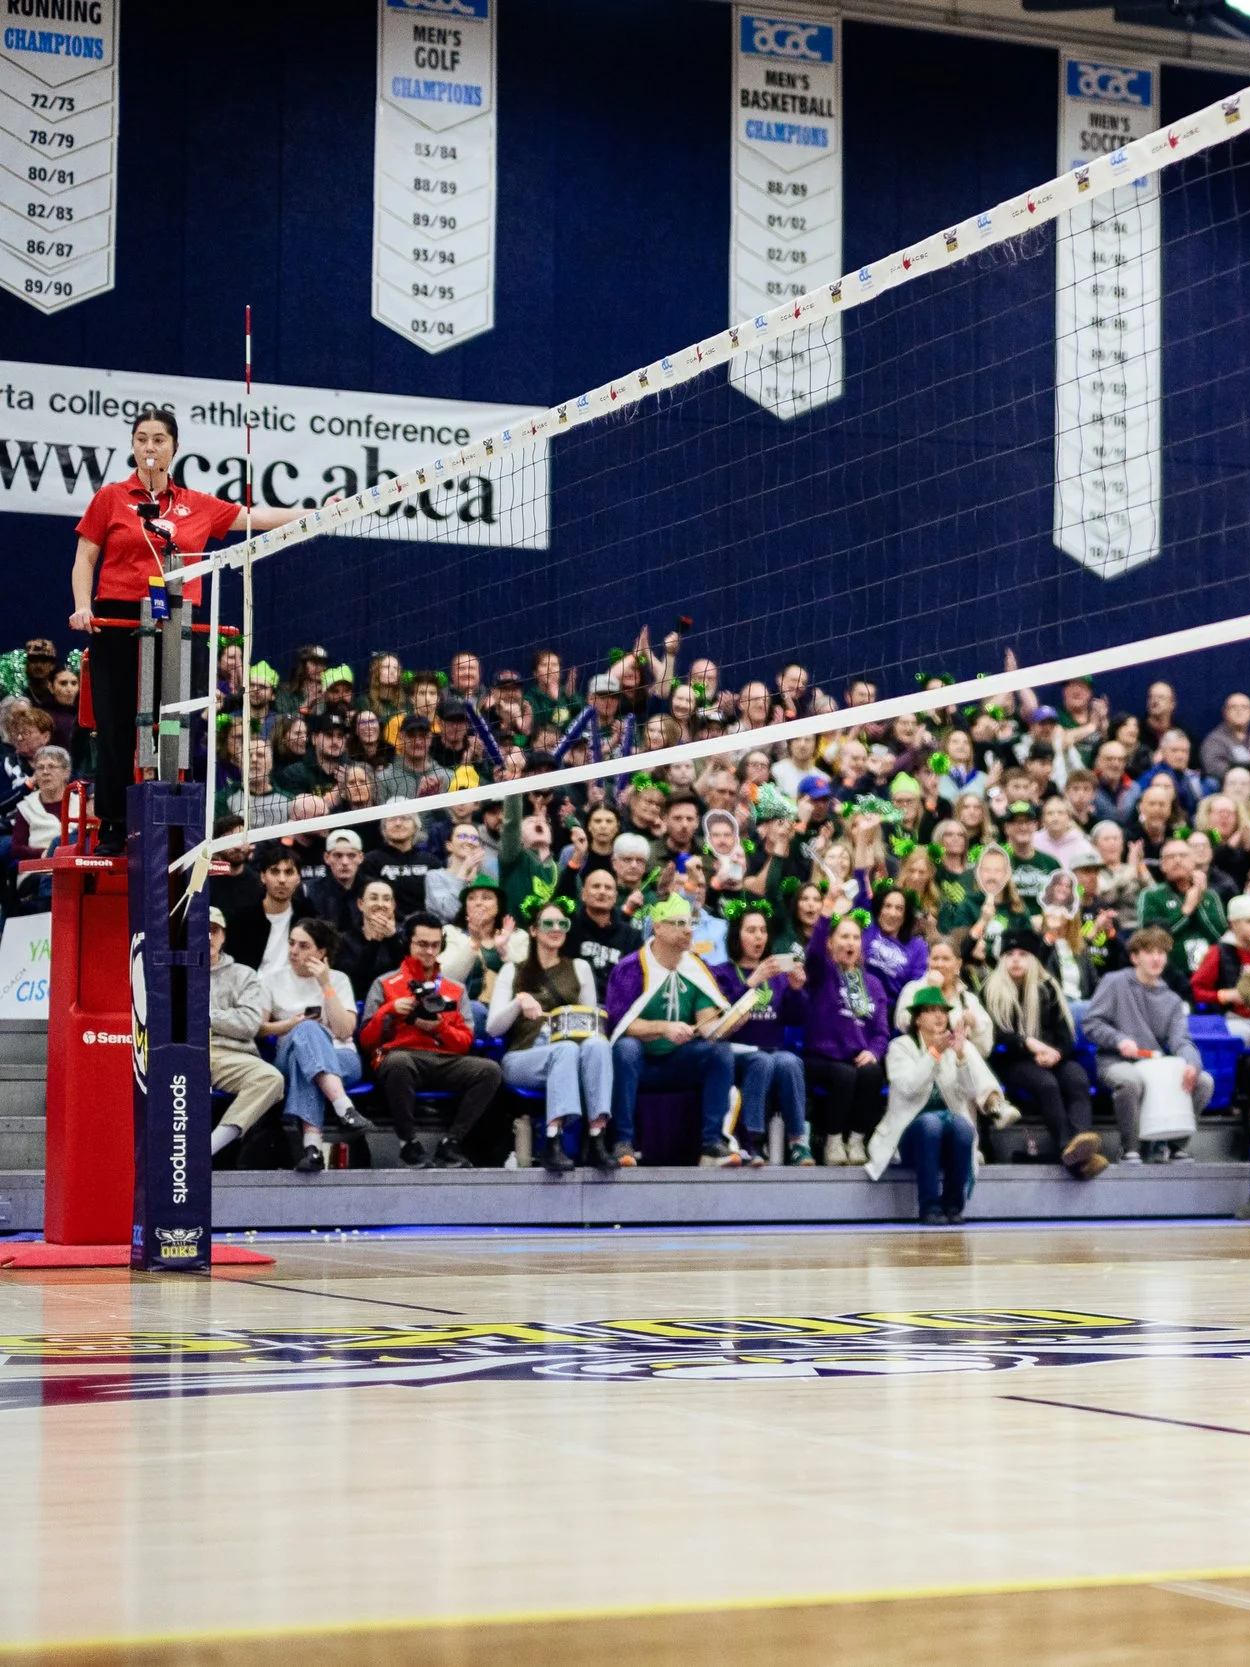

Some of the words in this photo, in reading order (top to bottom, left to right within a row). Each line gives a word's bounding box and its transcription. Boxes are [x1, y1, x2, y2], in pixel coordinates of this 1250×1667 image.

[7, 0, 102, 25] RUNNING
[4, 27, 104, 61] CHAMPIONS
[413, 24, 462, 47] MEN'S
[415, 46, 461, 72] GOLF
[765, 69, 810, 91] MEN'S
[391, 76, 483, 107] CHAMPIONS
[30, 93, 75, 111] 72/73
[740, 88, 833, 118] BASKETBALL
[1089, 112, 1130, 133] MEN'S
[29, 130, 74, 148] 78/79
[28, 166, 74, 185] 80/81
[413, 177, 457, 195] 88/89
[27, 203, 73, 221] 82/83
[412, 213, 457, 230] 89/90
[26, 240, 73, 258] 86/87
[412, 248, 455, 265] 93/94
[25, 279, 73, 296] 89/90
[411, 283, 455, 300] 94/95
[411, 319, 454, 336] 03/04
[191, 401, 296, 433] athletic
[309, 413, 470, 447] conference
[16, 979, 50, 1002] CIS
[170, 1074, 189, 1132] sports
[170, 1134, 189, 1204] imports
[161, 1245, 198, 1258] OOKS
